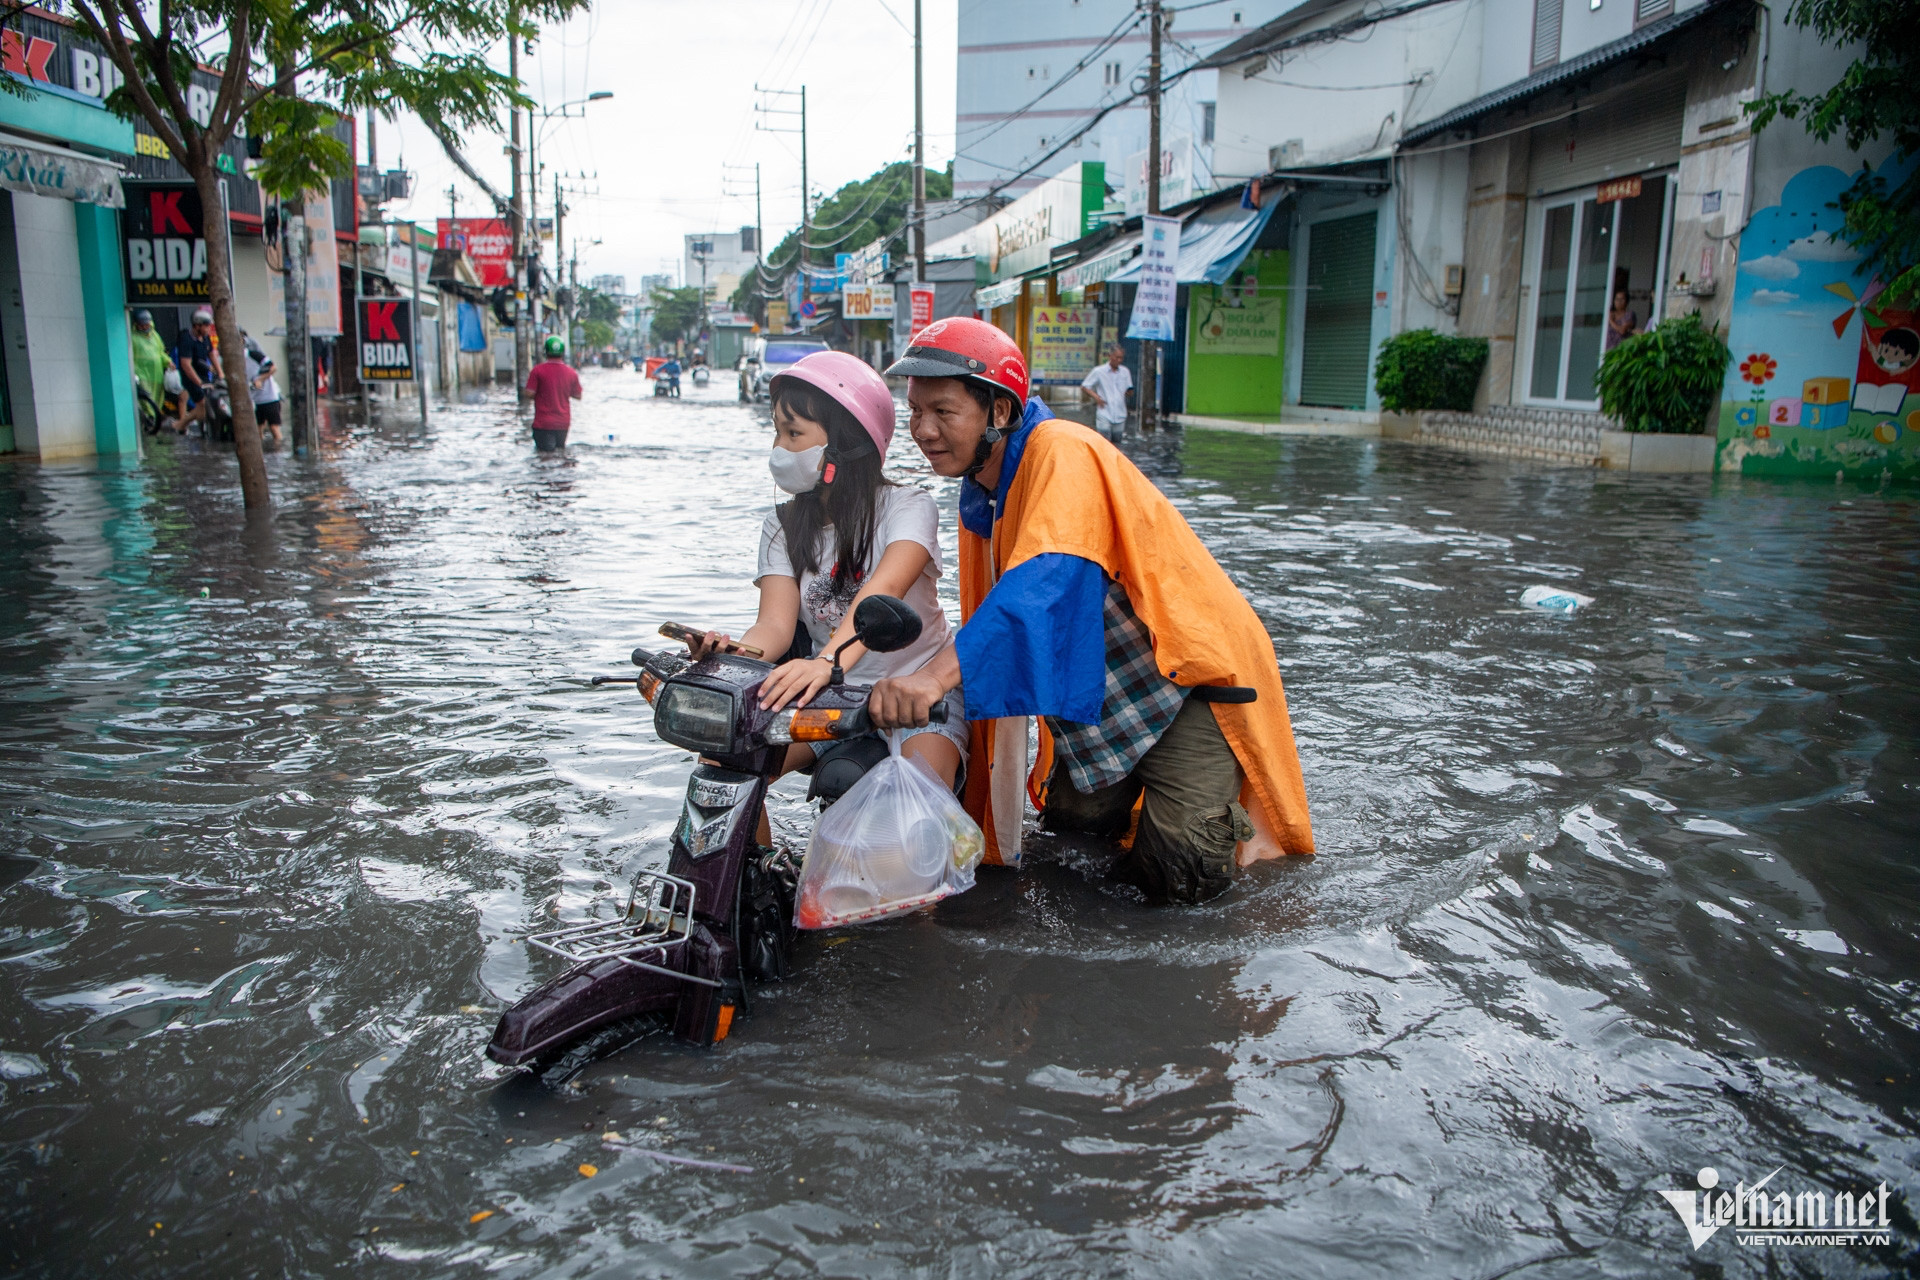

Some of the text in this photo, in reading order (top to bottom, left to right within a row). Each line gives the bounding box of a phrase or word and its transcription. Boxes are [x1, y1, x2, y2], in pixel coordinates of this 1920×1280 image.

[0, 26, 57, 84] K
[134, 132, 171, 161] IBRE
[150, 191, 193, 235] K
[128, 237, 209, 280] BIDA
[137, 282, 168, 296] 130A
[367, 301, 401, 340] K
[1037, 308, 1095, 323] A SÁT
[362, 342, 410, 367] BIDA
[1808, 386, 1820, 402] 1
[1775, 406, 1789, 423] 2
[1810, 407, 1821, 425] 3
